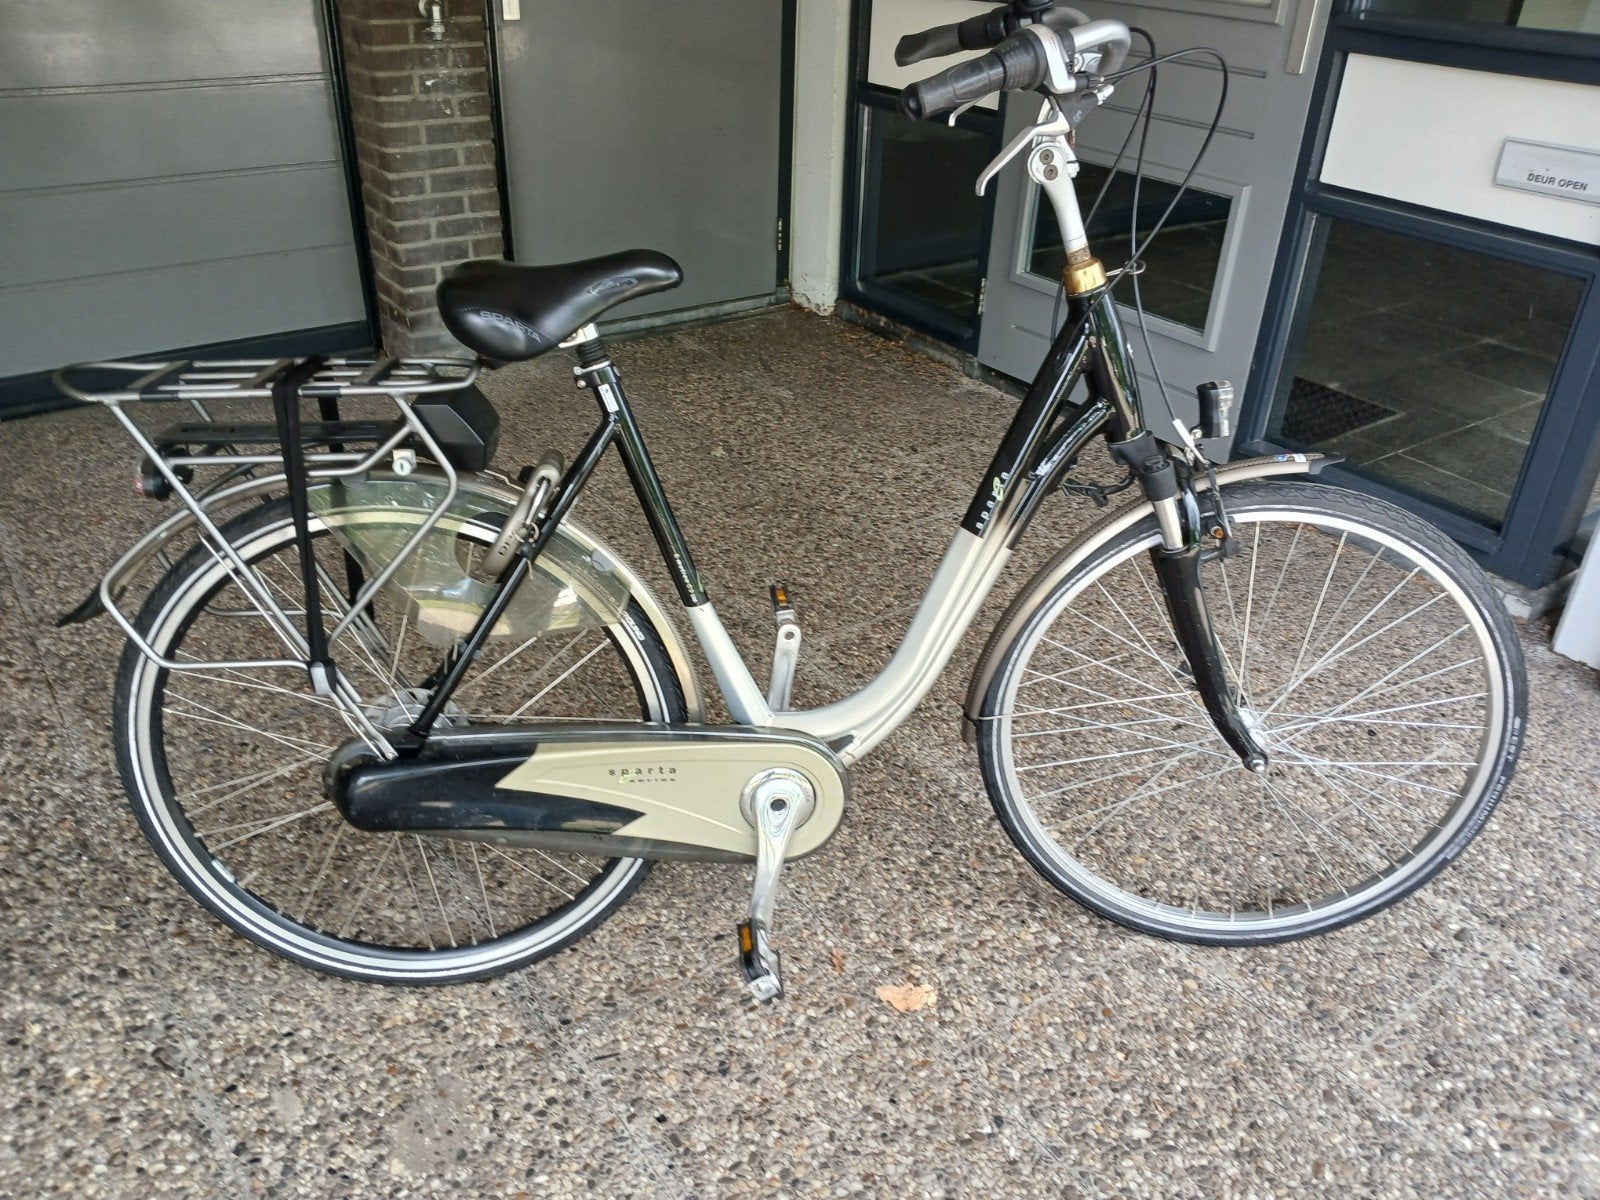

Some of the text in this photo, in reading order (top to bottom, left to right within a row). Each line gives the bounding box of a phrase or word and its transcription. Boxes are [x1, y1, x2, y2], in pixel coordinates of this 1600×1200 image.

[1527, 173, 1588, 191] DEUR OPEN
[479, 311, 541, 343] SPARTA
[608, 765, 677, 776] sparta
